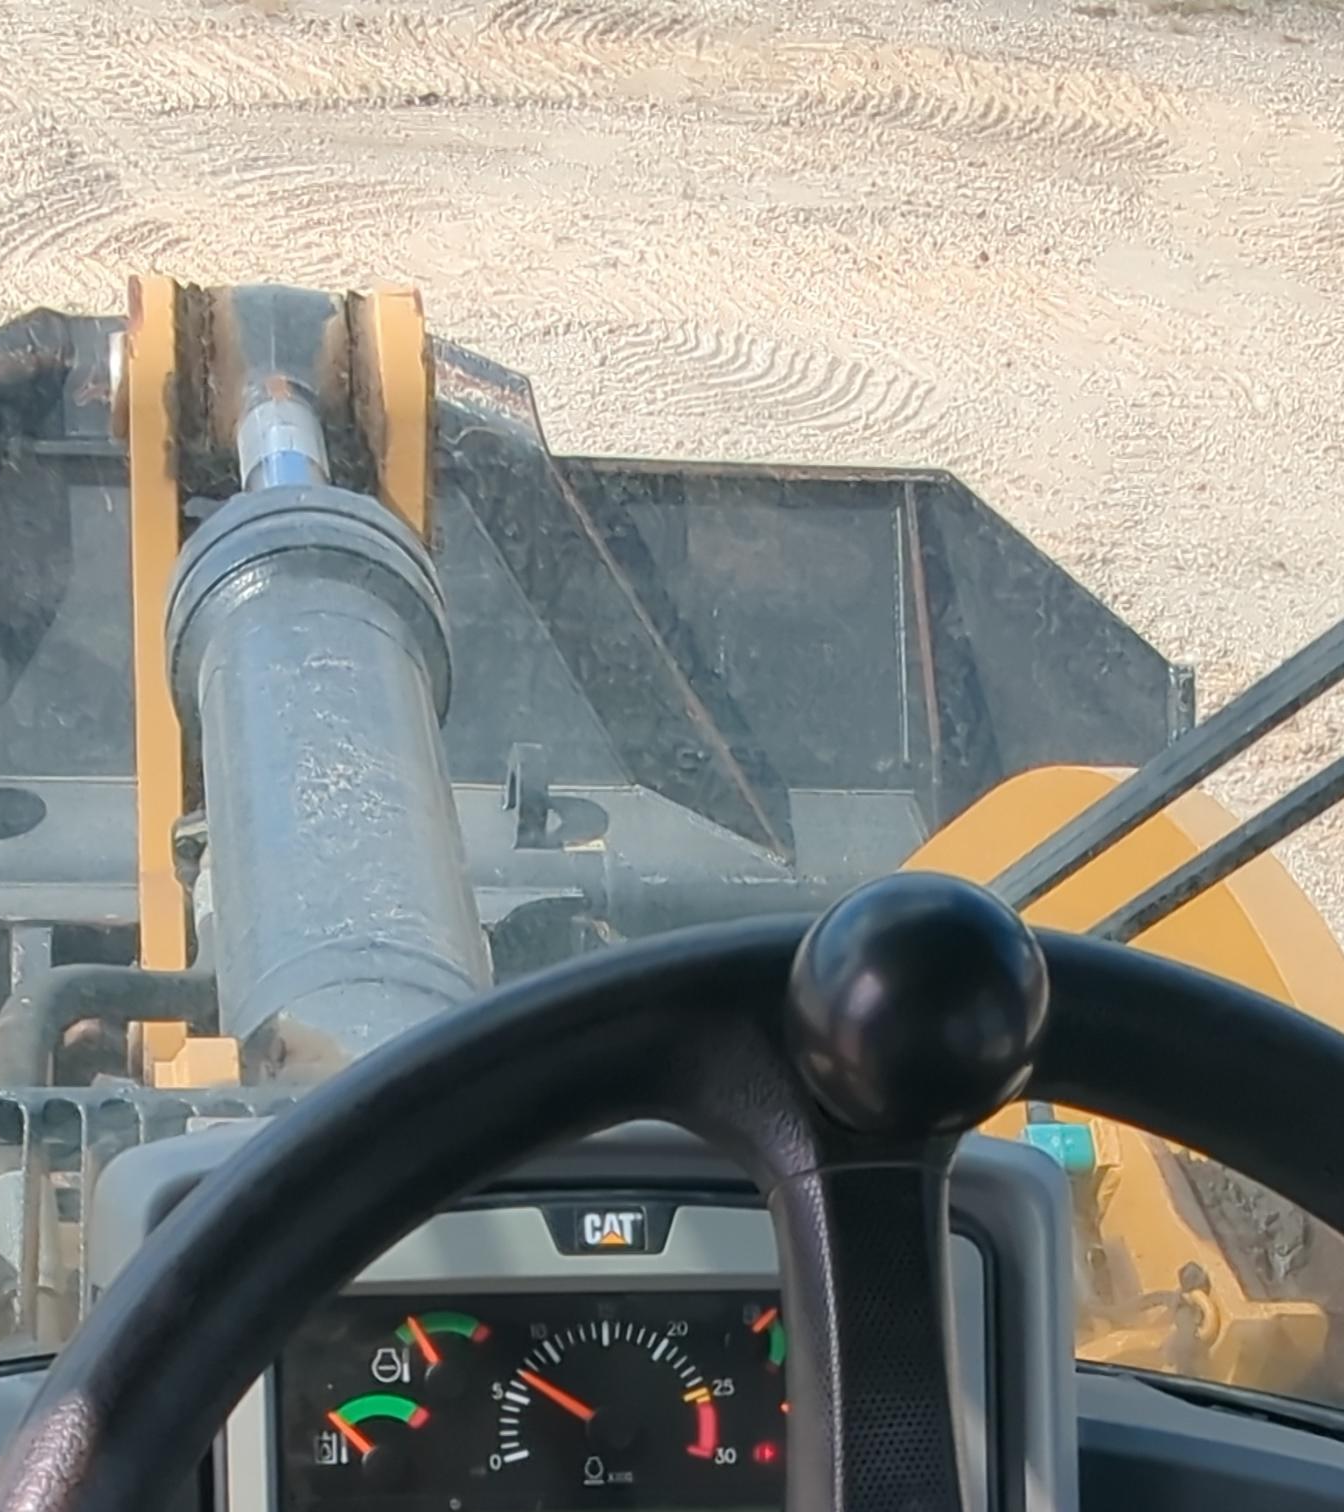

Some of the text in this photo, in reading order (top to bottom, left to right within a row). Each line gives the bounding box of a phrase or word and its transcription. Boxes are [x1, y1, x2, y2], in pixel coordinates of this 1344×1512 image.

[583, 1211, 643, 1246] CAT
[667, 1320, 688, 1336] 20
[491, 1382, 503, 1400] 5
[712, 1379, 735, 1397] 25
[489, 1453, 502, 1471] 0
[714, 1447, 737, 1465] 30
